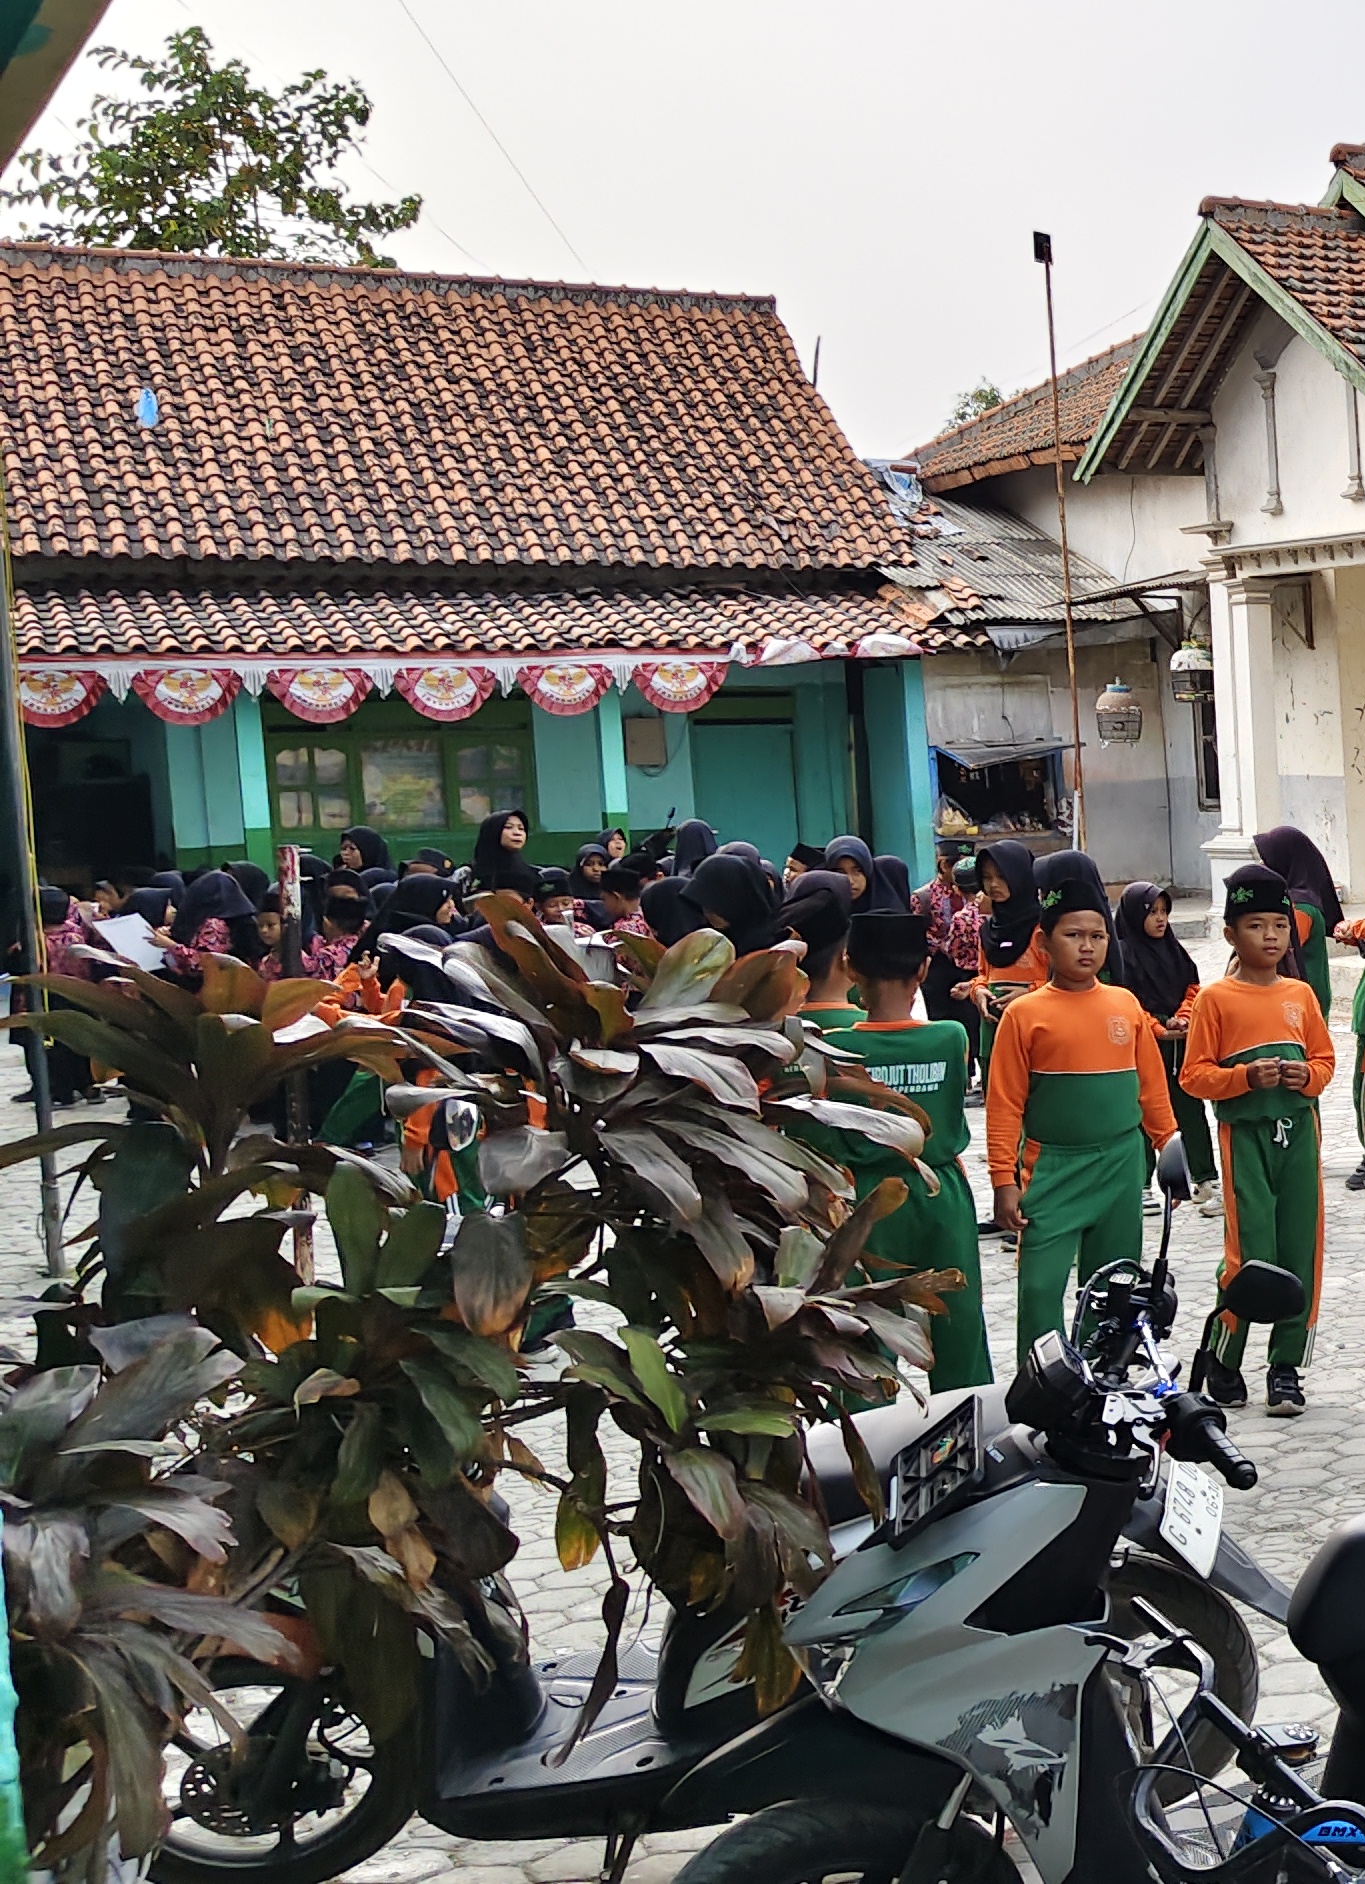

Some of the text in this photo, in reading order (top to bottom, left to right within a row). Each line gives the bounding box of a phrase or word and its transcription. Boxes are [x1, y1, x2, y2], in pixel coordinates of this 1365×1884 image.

[1172, 1480, 1196, 1525] 6748
[1168, 1524, 1187, 1546] G
[1318, 1826, 1359, 1838] BMX
